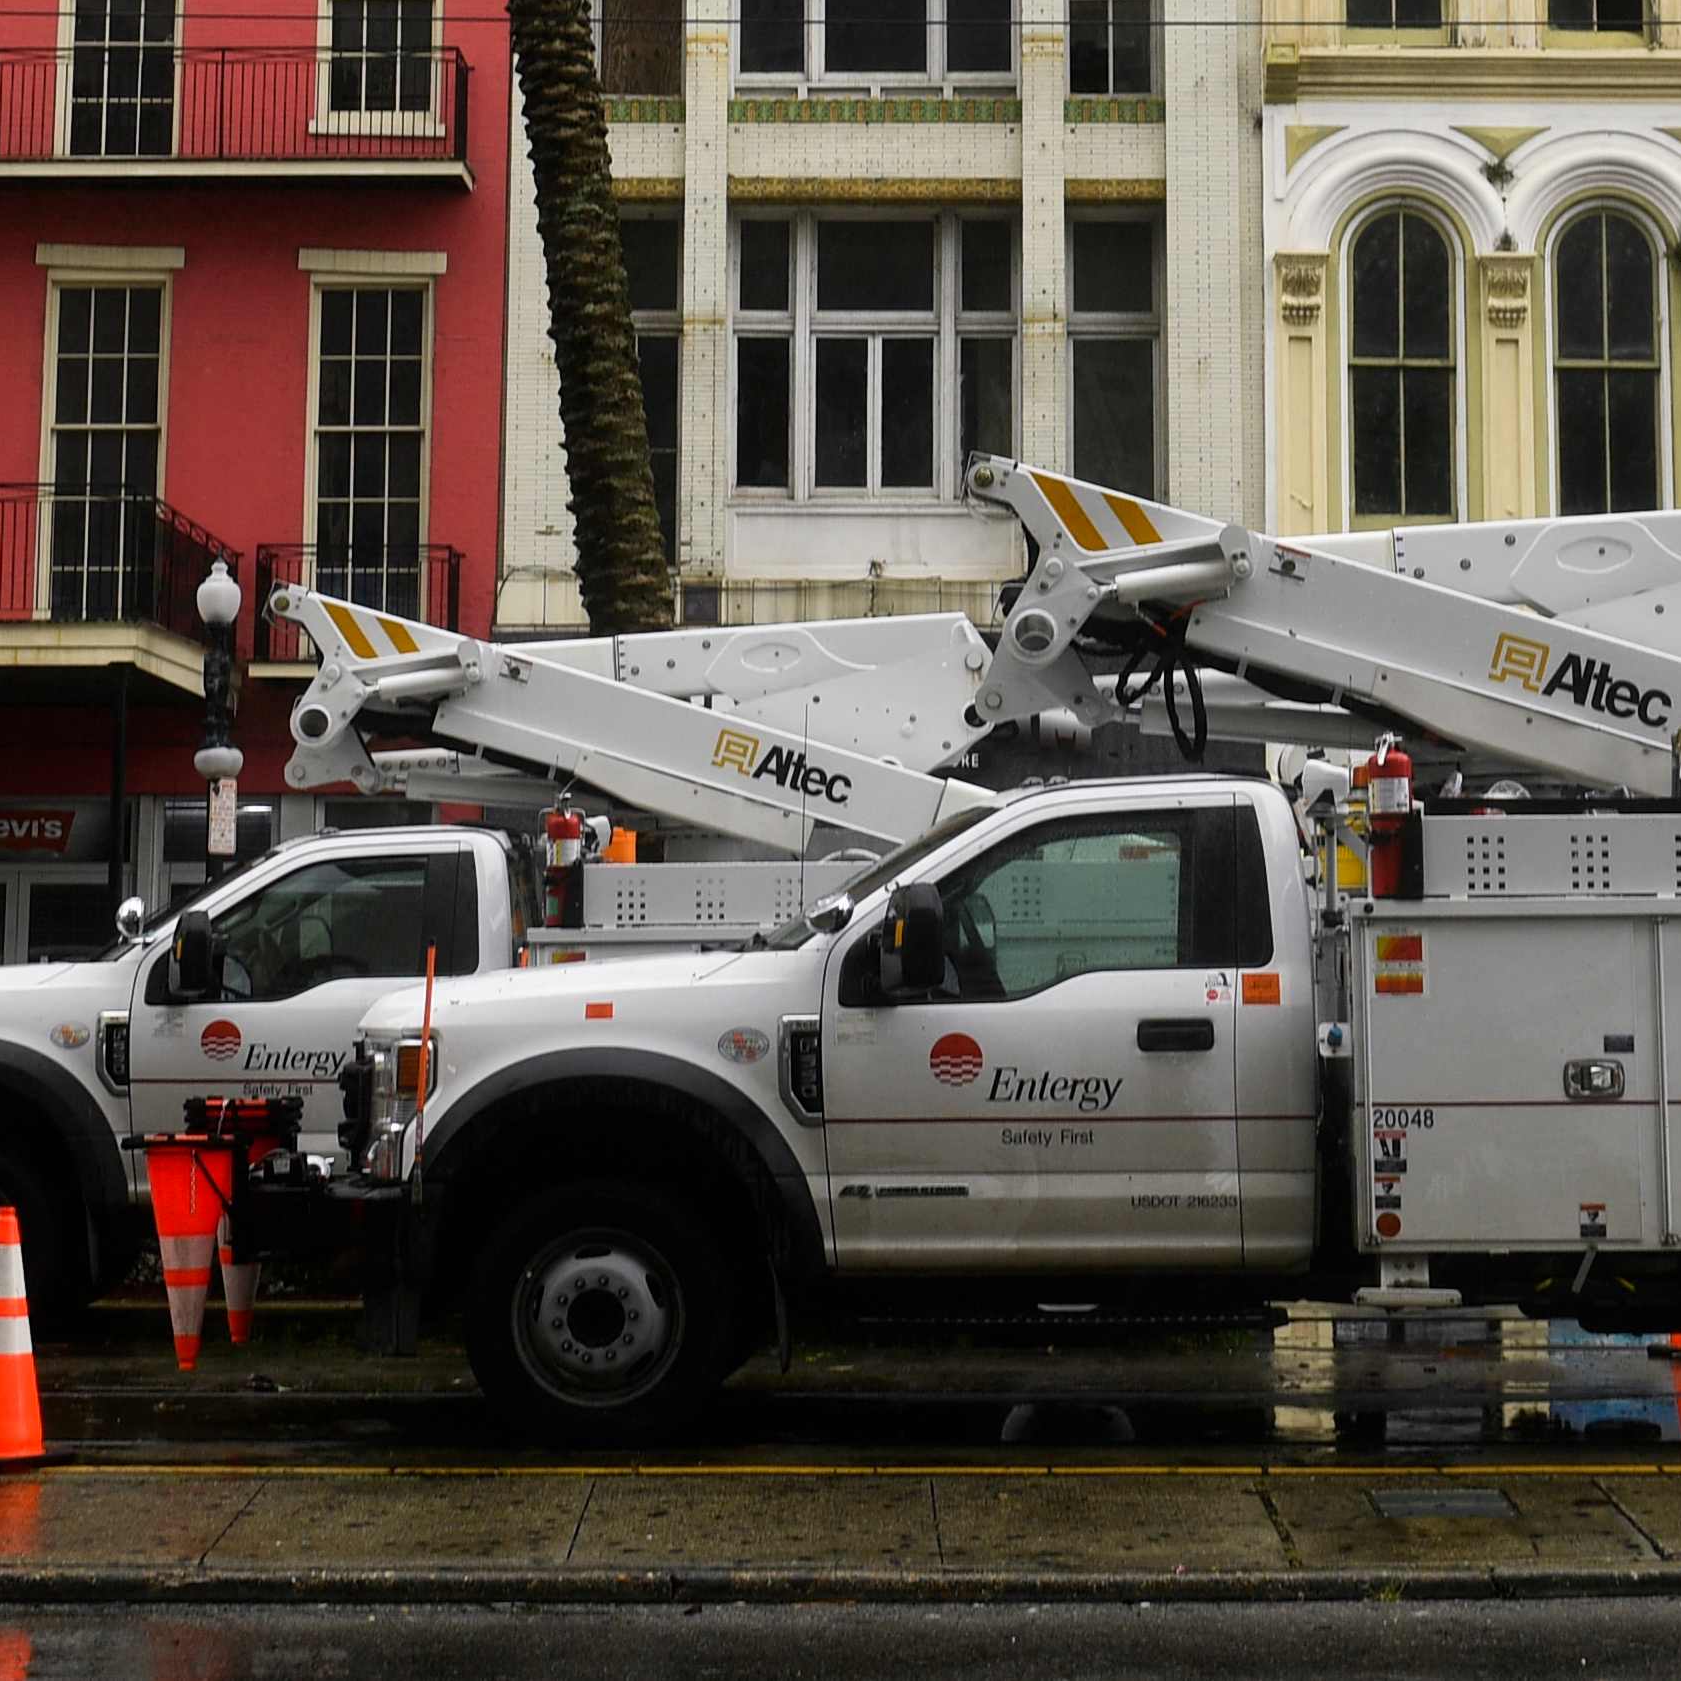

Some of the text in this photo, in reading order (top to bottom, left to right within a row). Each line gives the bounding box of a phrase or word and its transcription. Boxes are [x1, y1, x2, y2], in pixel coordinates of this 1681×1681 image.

[1542, 651, 1673, 729] Altec
[752, 744, 853, 805] Altec
[242, 1042, 348, 1077] Entergy
[243, 1083, 314, 1097] Safety First
[987, 1067, 1123, 1112] Entergy
[1373, 1108, 1434, 1129] 20048
[1001, 1129, 1094, 1148] Safety First
[1131, 1195, 1179, 1208] USDOT
